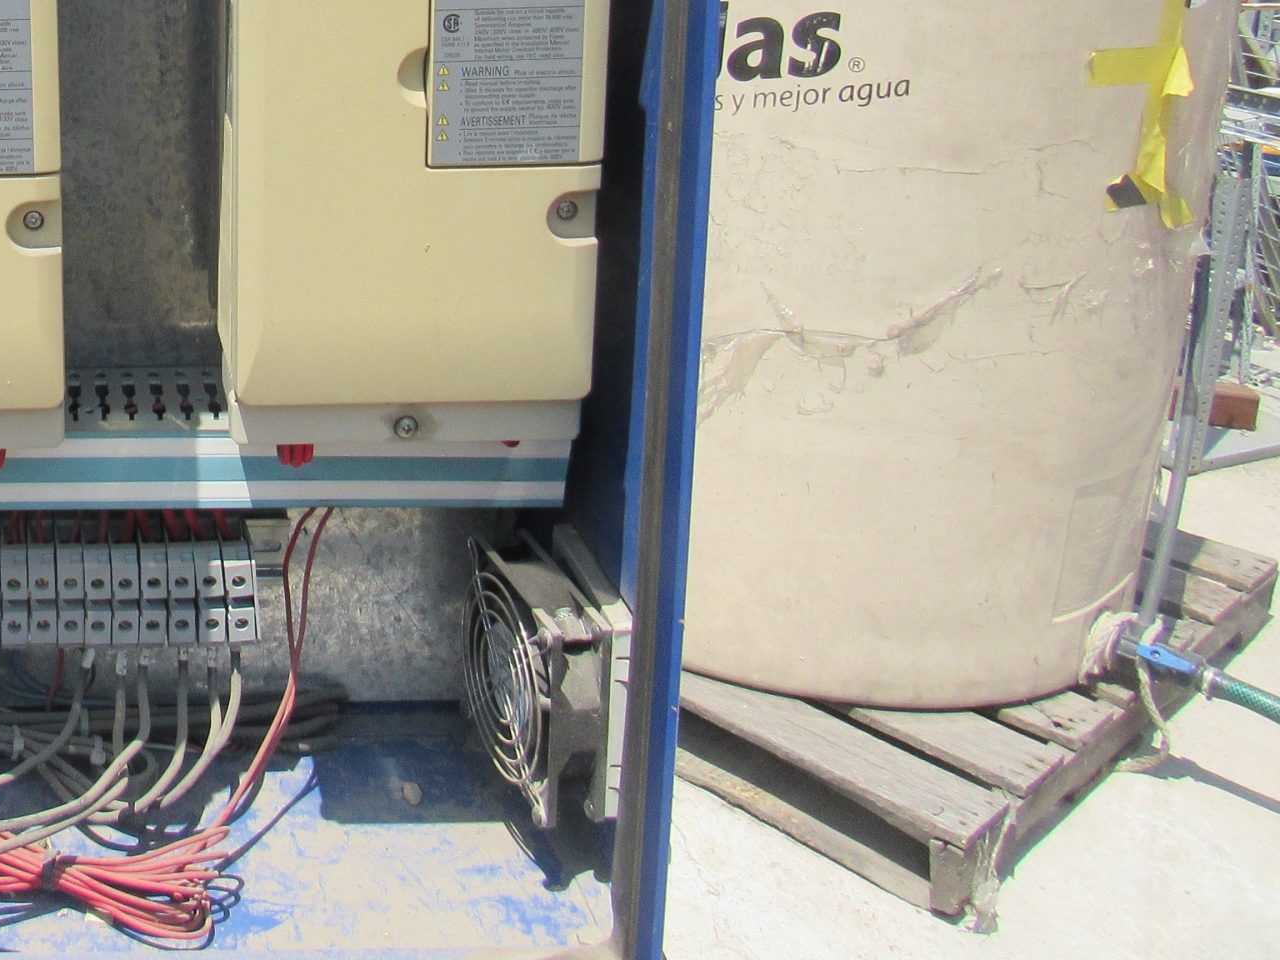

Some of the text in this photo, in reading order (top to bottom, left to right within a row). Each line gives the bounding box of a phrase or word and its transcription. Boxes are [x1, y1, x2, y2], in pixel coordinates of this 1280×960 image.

[461, 66, 510, 77] WARNING
[731, 93, 745, 116] y
[753, 83, 831, 113] mejor
[838, 79, 910, 108] agua
[461, 115, 526, 127] AVERTISSEMENT
